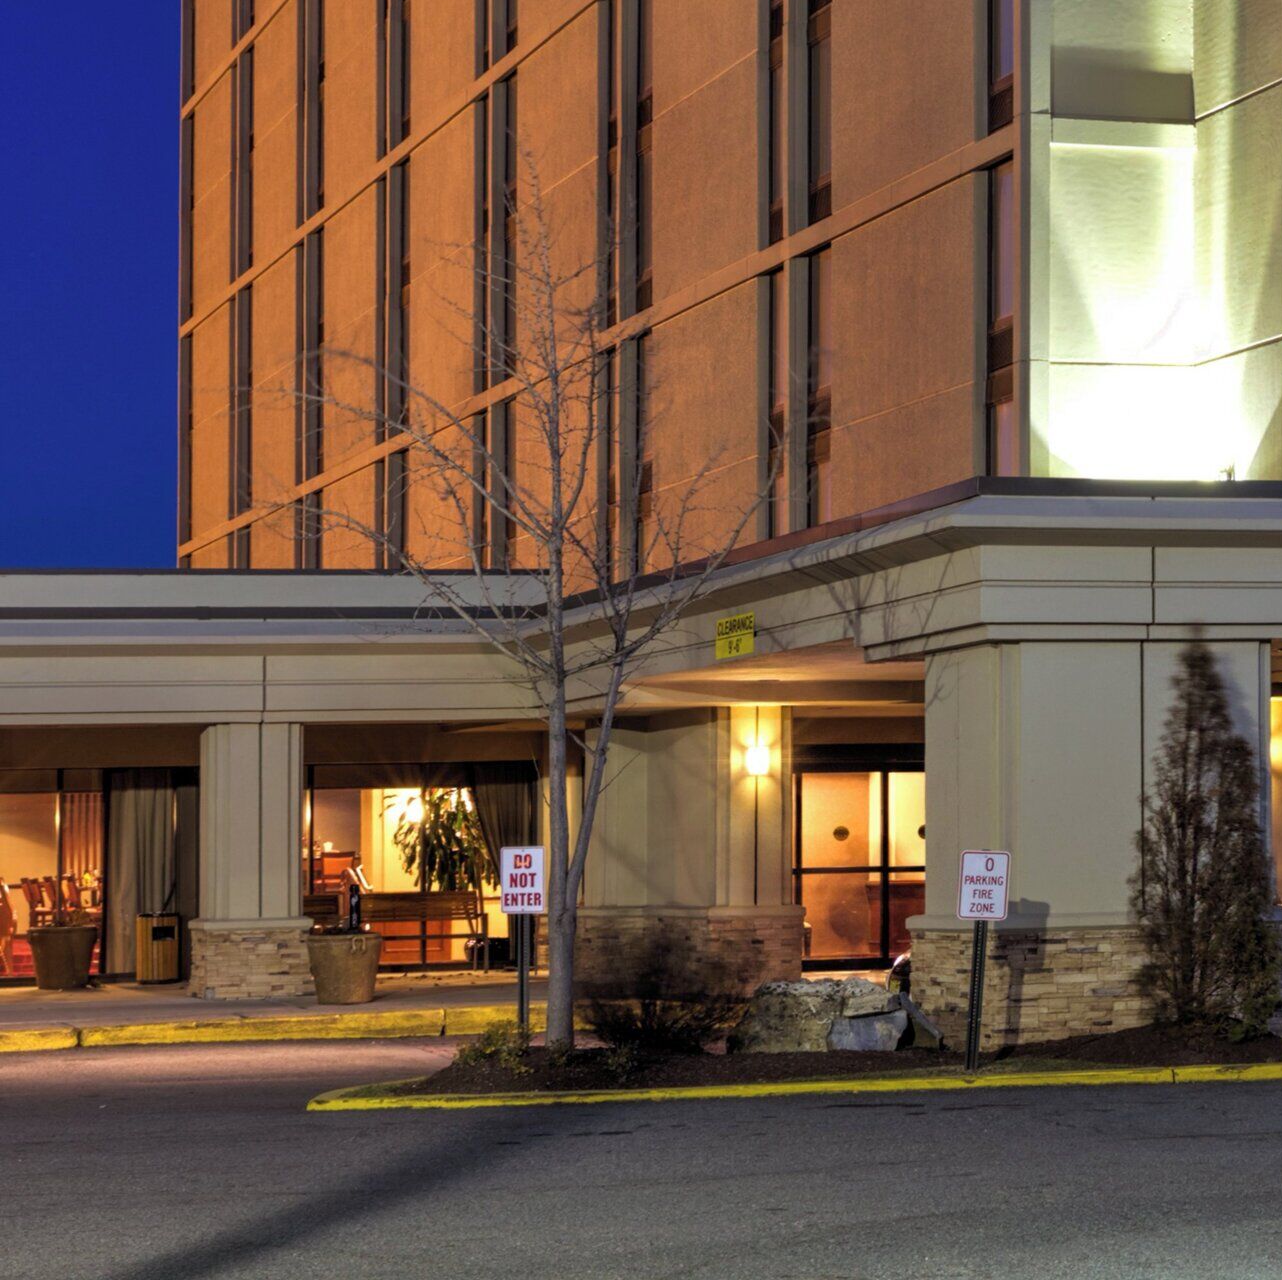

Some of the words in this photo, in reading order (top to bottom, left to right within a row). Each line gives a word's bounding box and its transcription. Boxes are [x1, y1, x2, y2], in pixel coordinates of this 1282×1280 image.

[717, 615, 753, 636] CLEARANCE
[514, 854, 532, 869] DO
[509, 873, 537, 888] NOT
[964, 875, 1004, 886] PARKING
[504, 893, 541, 906] ENTER
[972, 889, 993, 899] FIRE
[969, 902, 995, 913] ZONE
